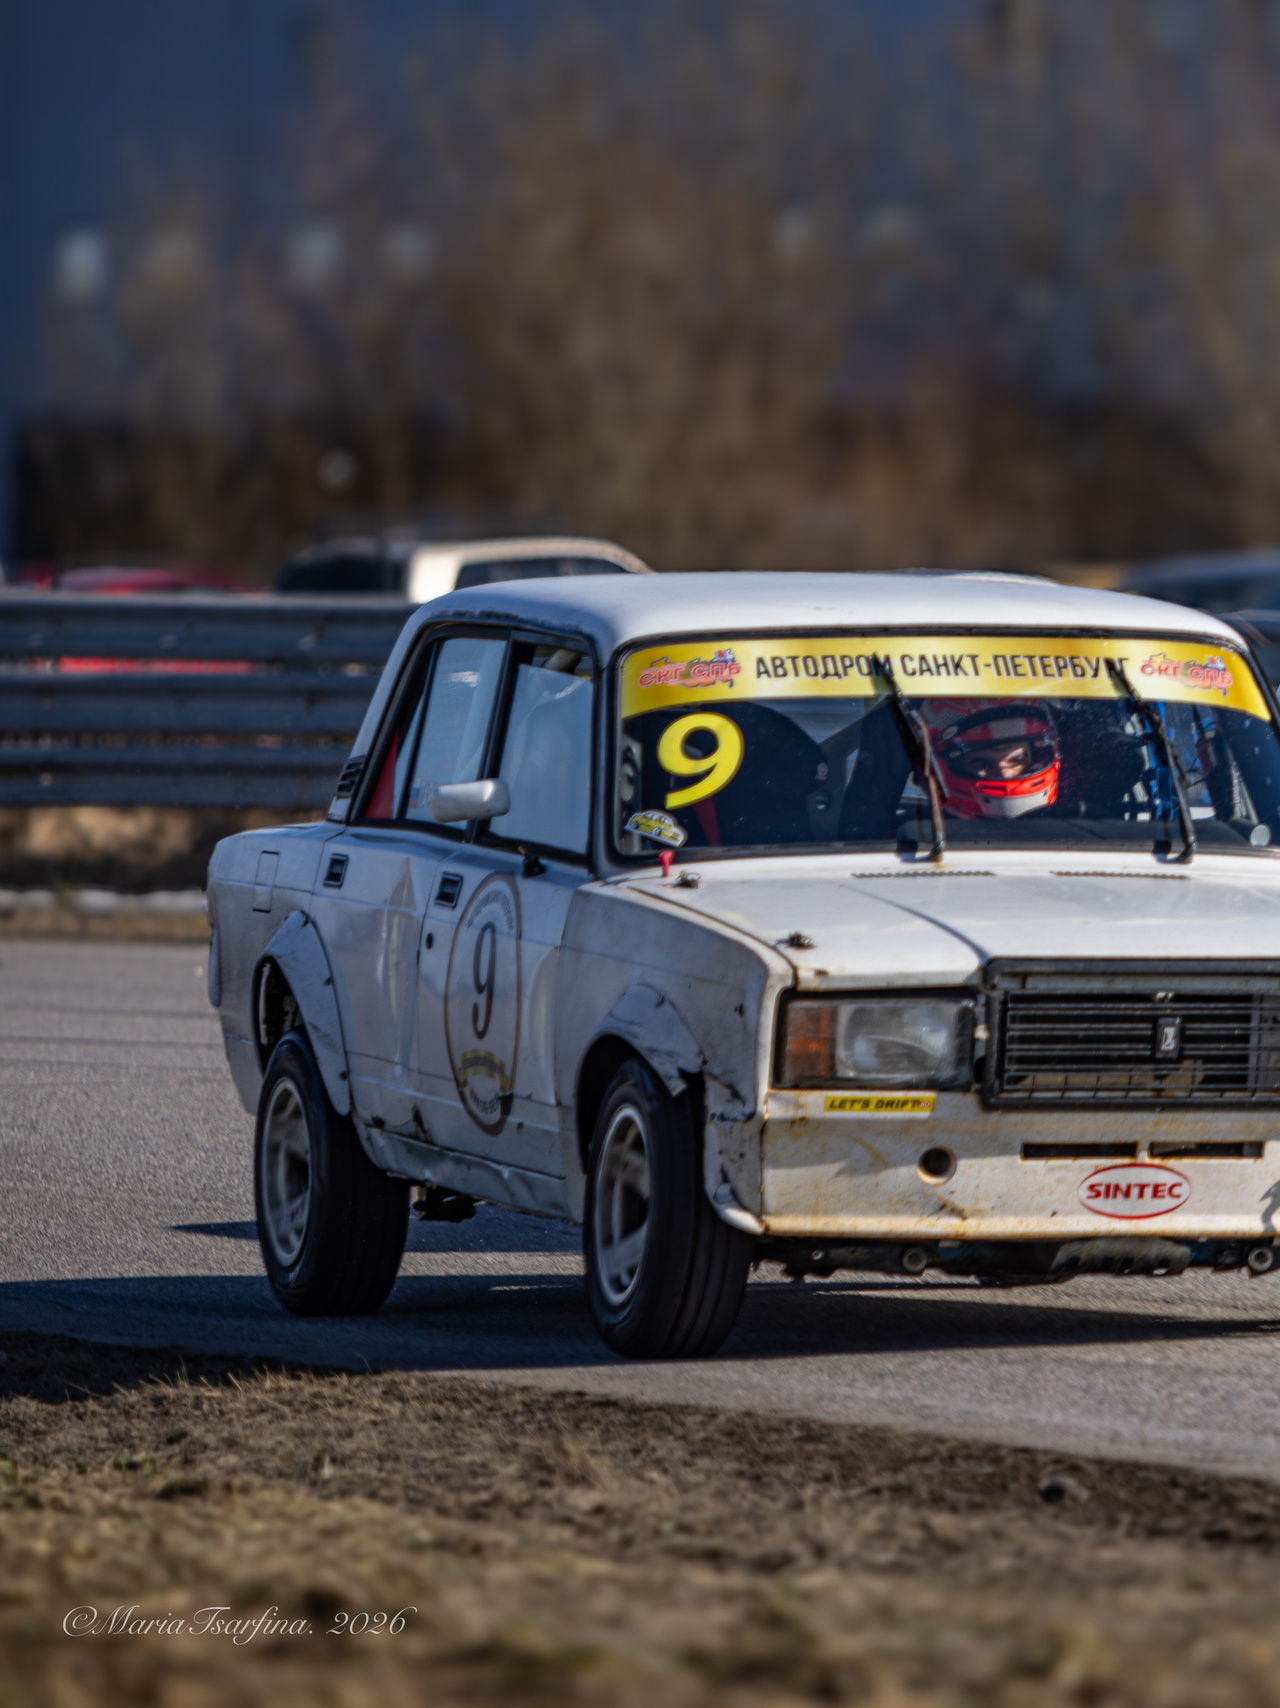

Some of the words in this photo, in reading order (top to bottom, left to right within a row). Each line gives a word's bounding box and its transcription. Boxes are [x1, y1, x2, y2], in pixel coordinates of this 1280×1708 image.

[639, 666, 684, 688] СКГ
[691, 662, 741, 679] СПБ
[657, 712, 744, 811] 9
[471, 920, 497, 1041] 9
[828, 1098, 871, 1109] LET'S
[1086, 1182, 1183, 1200] SINTEC
